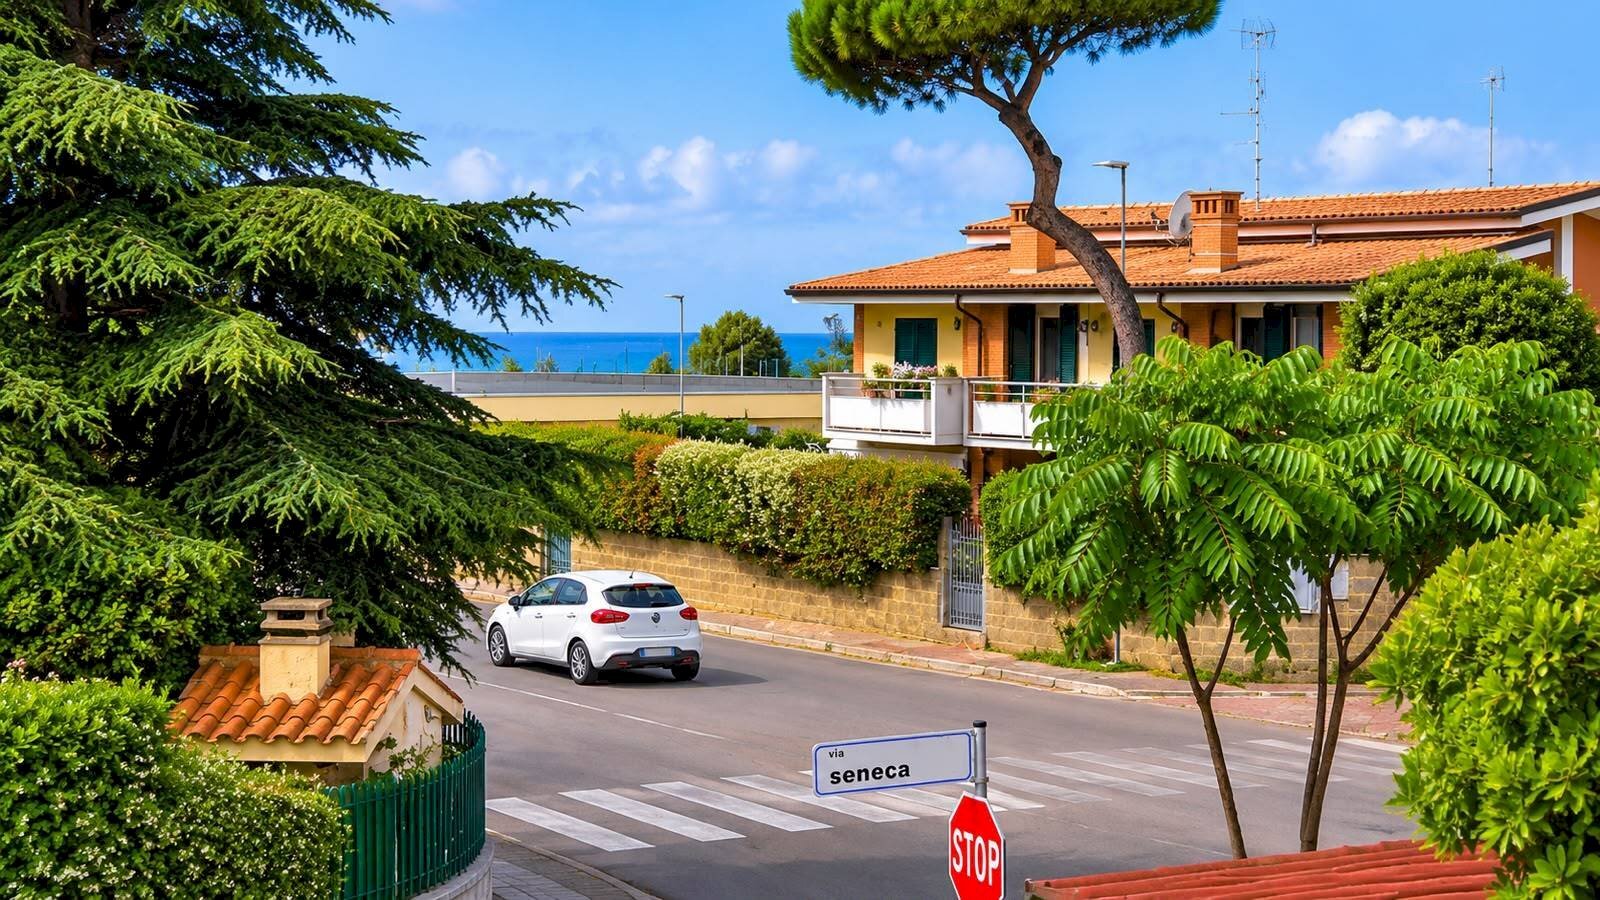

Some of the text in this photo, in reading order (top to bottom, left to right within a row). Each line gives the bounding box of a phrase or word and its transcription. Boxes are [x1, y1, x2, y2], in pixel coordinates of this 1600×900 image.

[828, 748, 845, 758] via
[830, 764, 911, 785] seneca
[952, 828, 1000, 886] STOP
